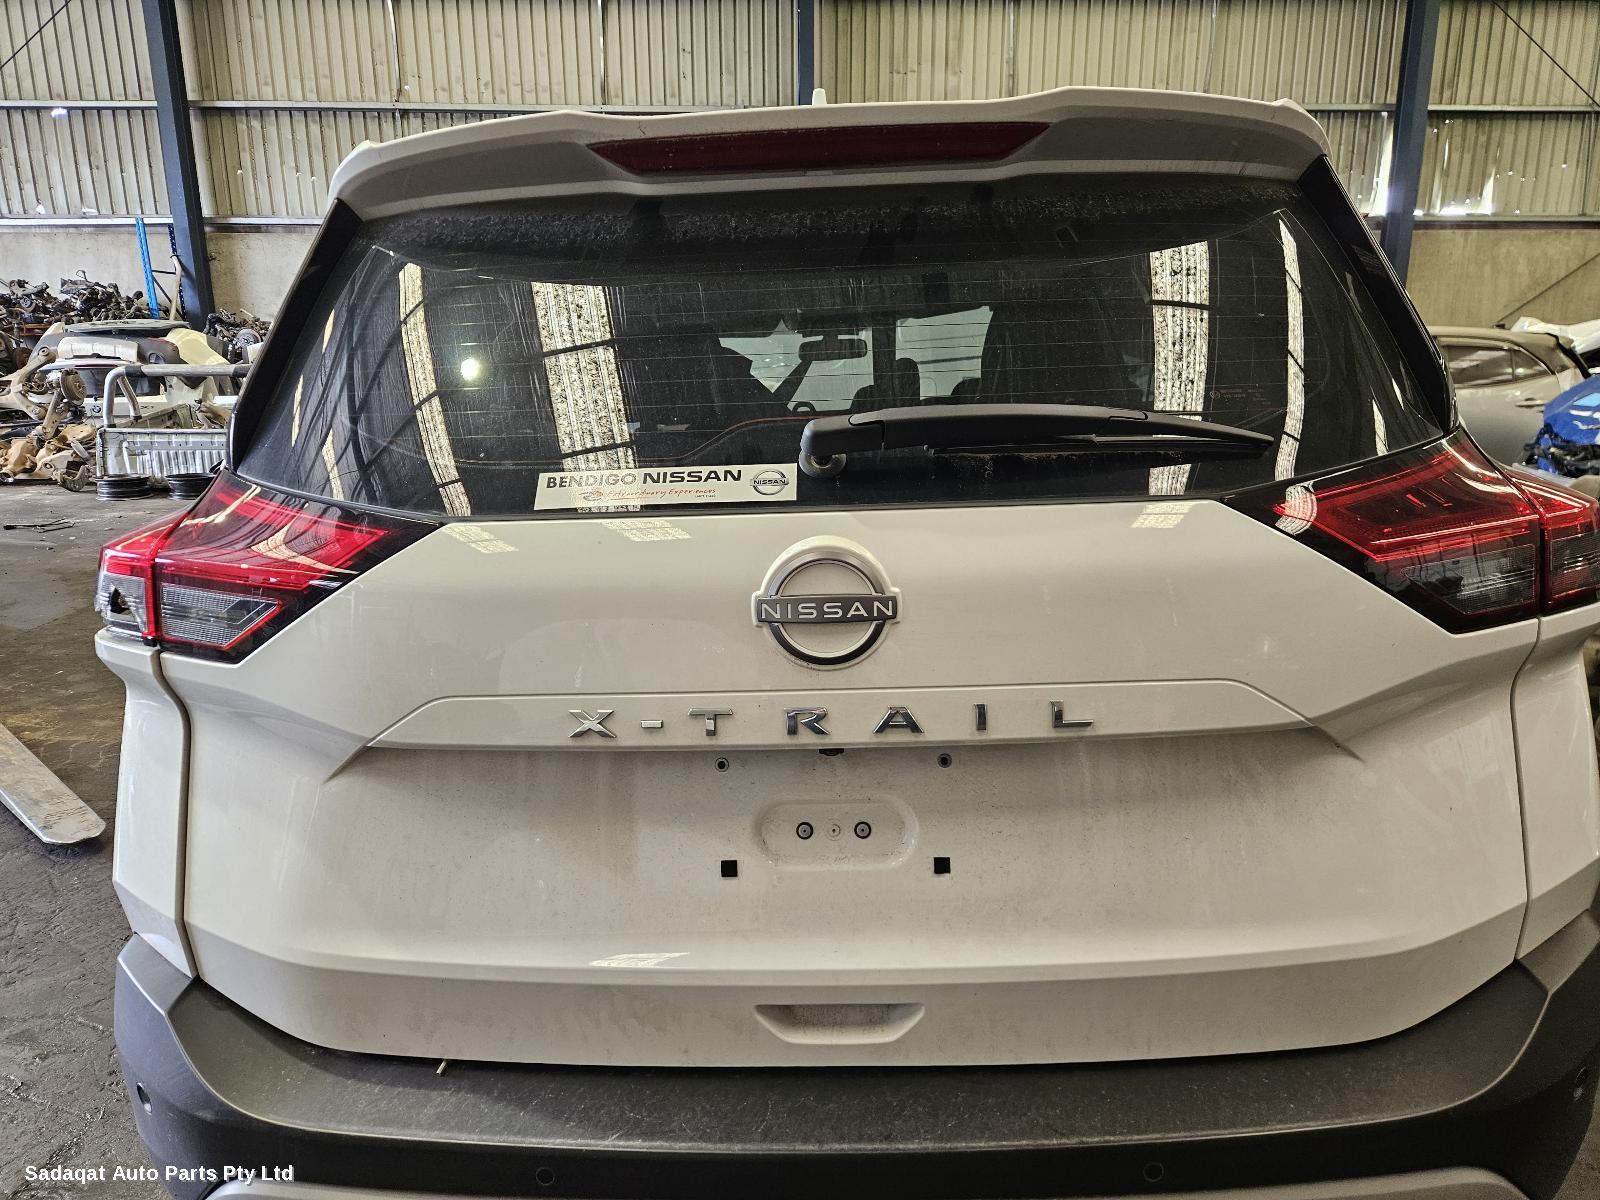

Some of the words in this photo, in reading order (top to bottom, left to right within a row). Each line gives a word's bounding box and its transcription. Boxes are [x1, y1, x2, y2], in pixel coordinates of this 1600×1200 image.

[546, 472, 637, 489] BENDIGO
[642, 469, 743, 485] NISSAN
[668, 488, 717, 497] Experiences
[761, 600, 893, 619] NISSAN
[567, 700, 1095, 739] X-TRAIL
